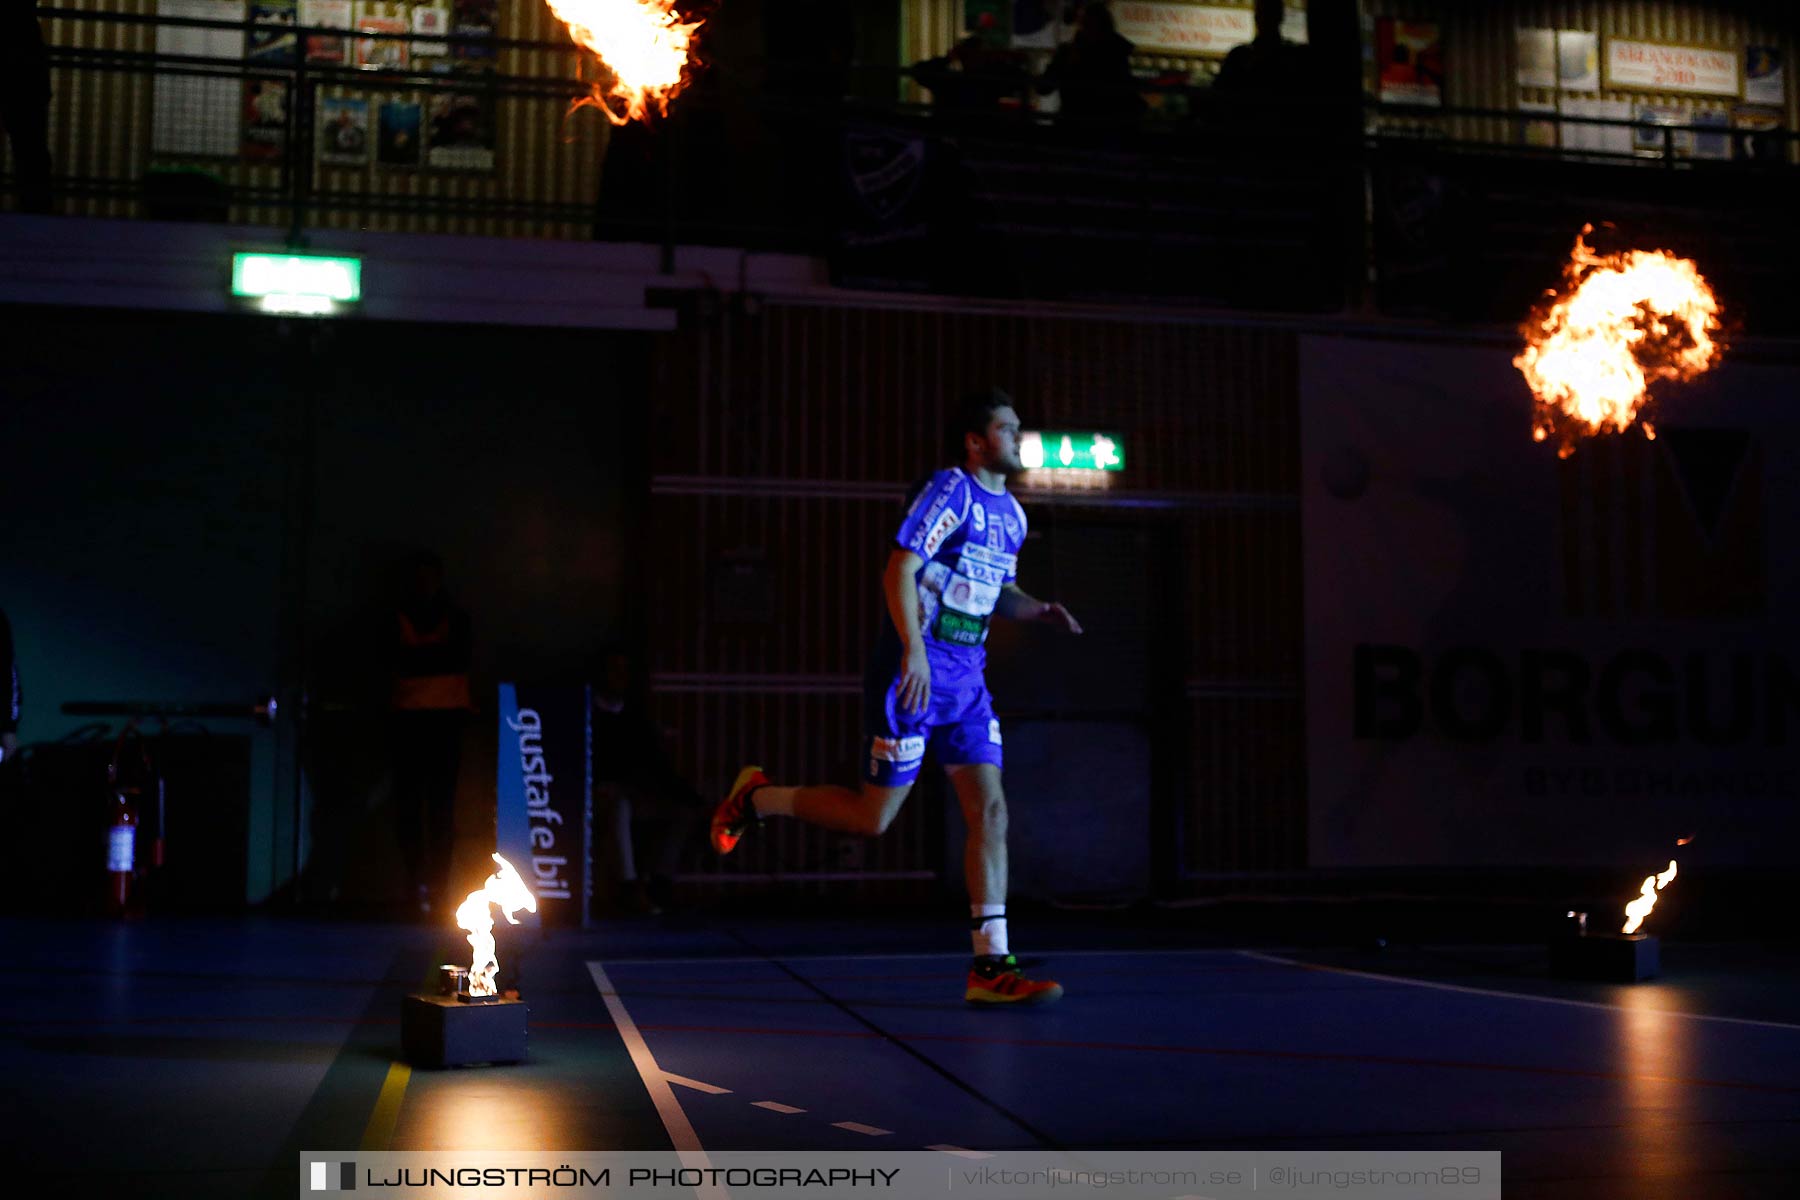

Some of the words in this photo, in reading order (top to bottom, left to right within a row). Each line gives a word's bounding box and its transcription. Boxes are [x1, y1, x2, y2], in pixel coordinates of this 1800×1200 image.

[972, 502, 986, 531] 9
[506, 707, 563, 825] gustaf
[531, 855, 572, 899] bil
